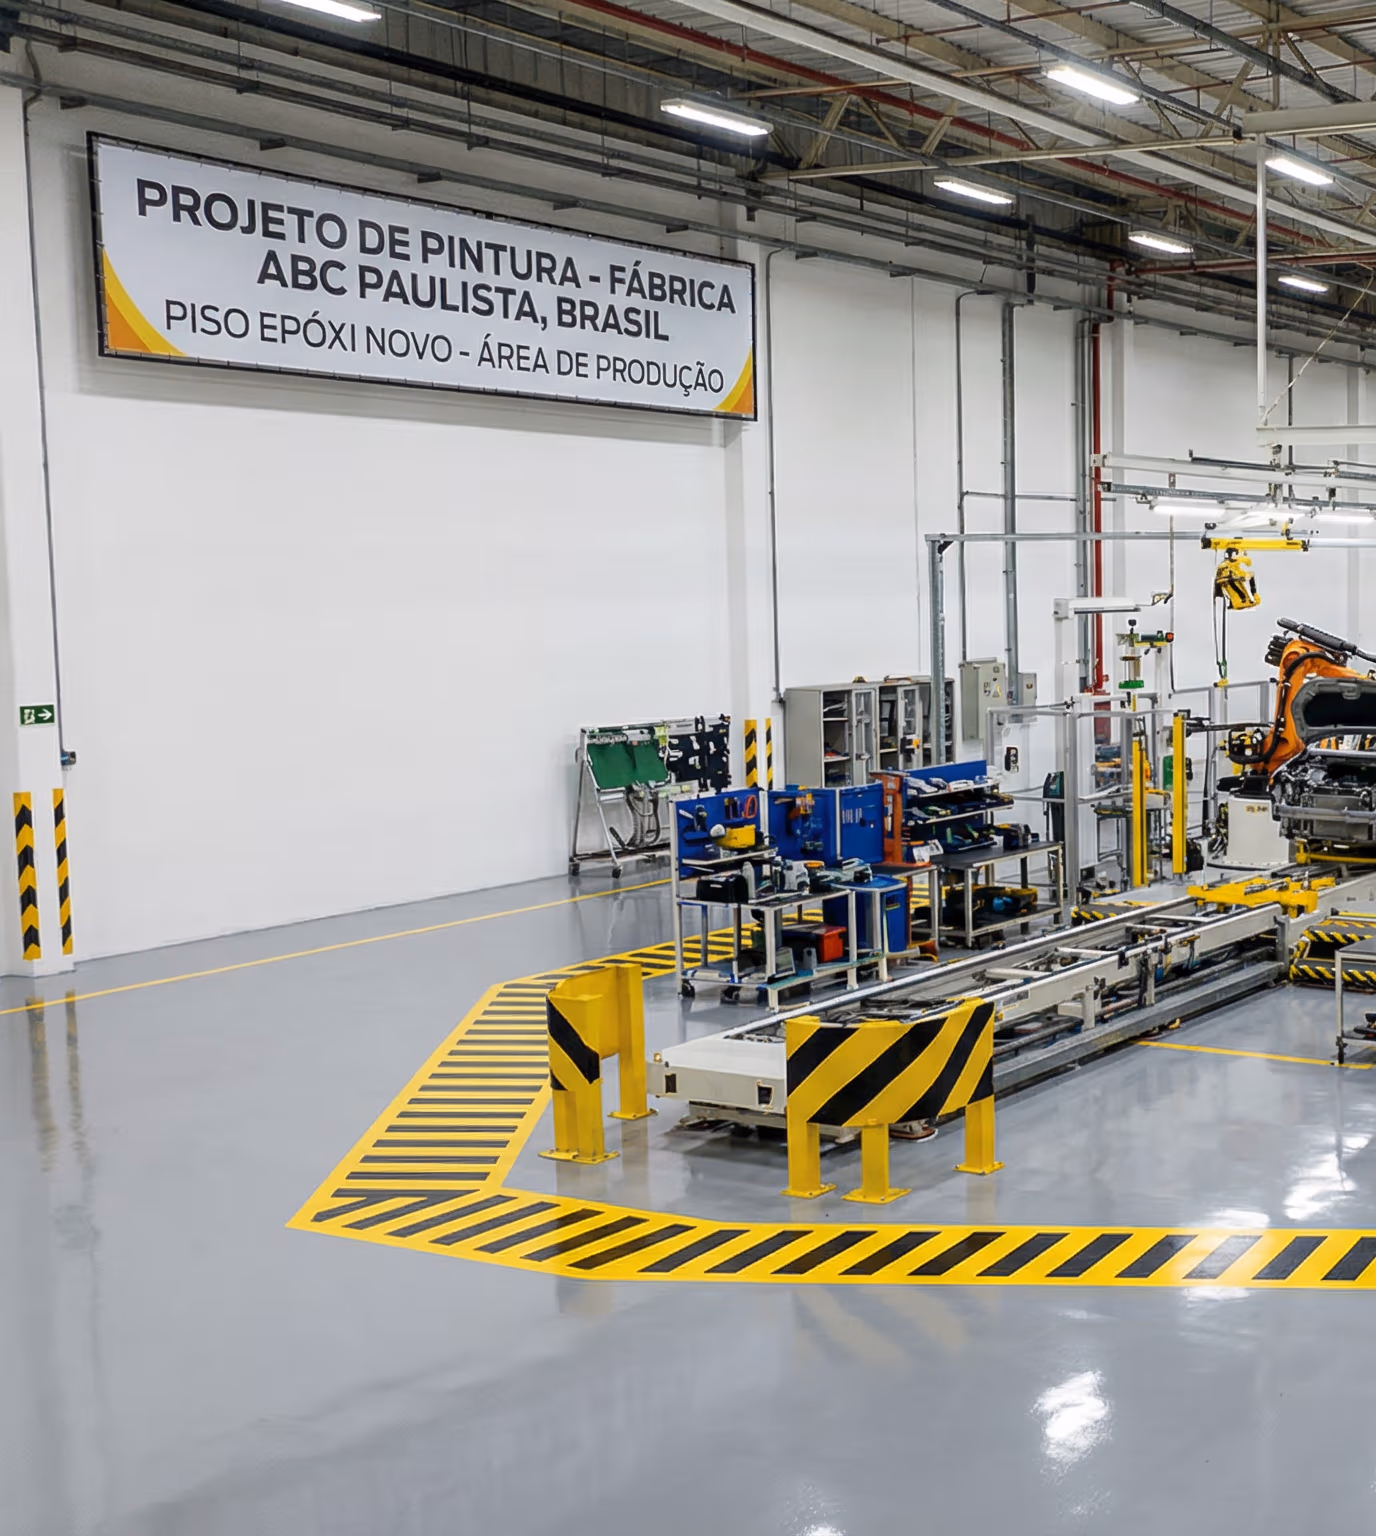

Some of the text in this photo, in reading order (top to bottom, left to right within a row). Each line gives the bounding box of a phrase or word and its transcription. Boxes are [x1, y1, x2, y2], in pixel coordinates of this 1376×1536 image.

[136, 177, 348, 250] PROJETO
[358, 218, 411, 262] DE
[420, 229, 582, 289] PINTURA
[609, 259, 737, 315] FÁBRICA
[256, 249, 670, 342] ABC PAULISTA, BRASIL
[165, 299, 250, 339] PISO
[259, 310, 356, 353] EPÓXI
[365, 325, 453, 363] NOVO
[477, 332, 550, 375] ÁREA
[556, 349, 589, 379] DE
[596, 354, 724, 398] PRODUÇÃO
